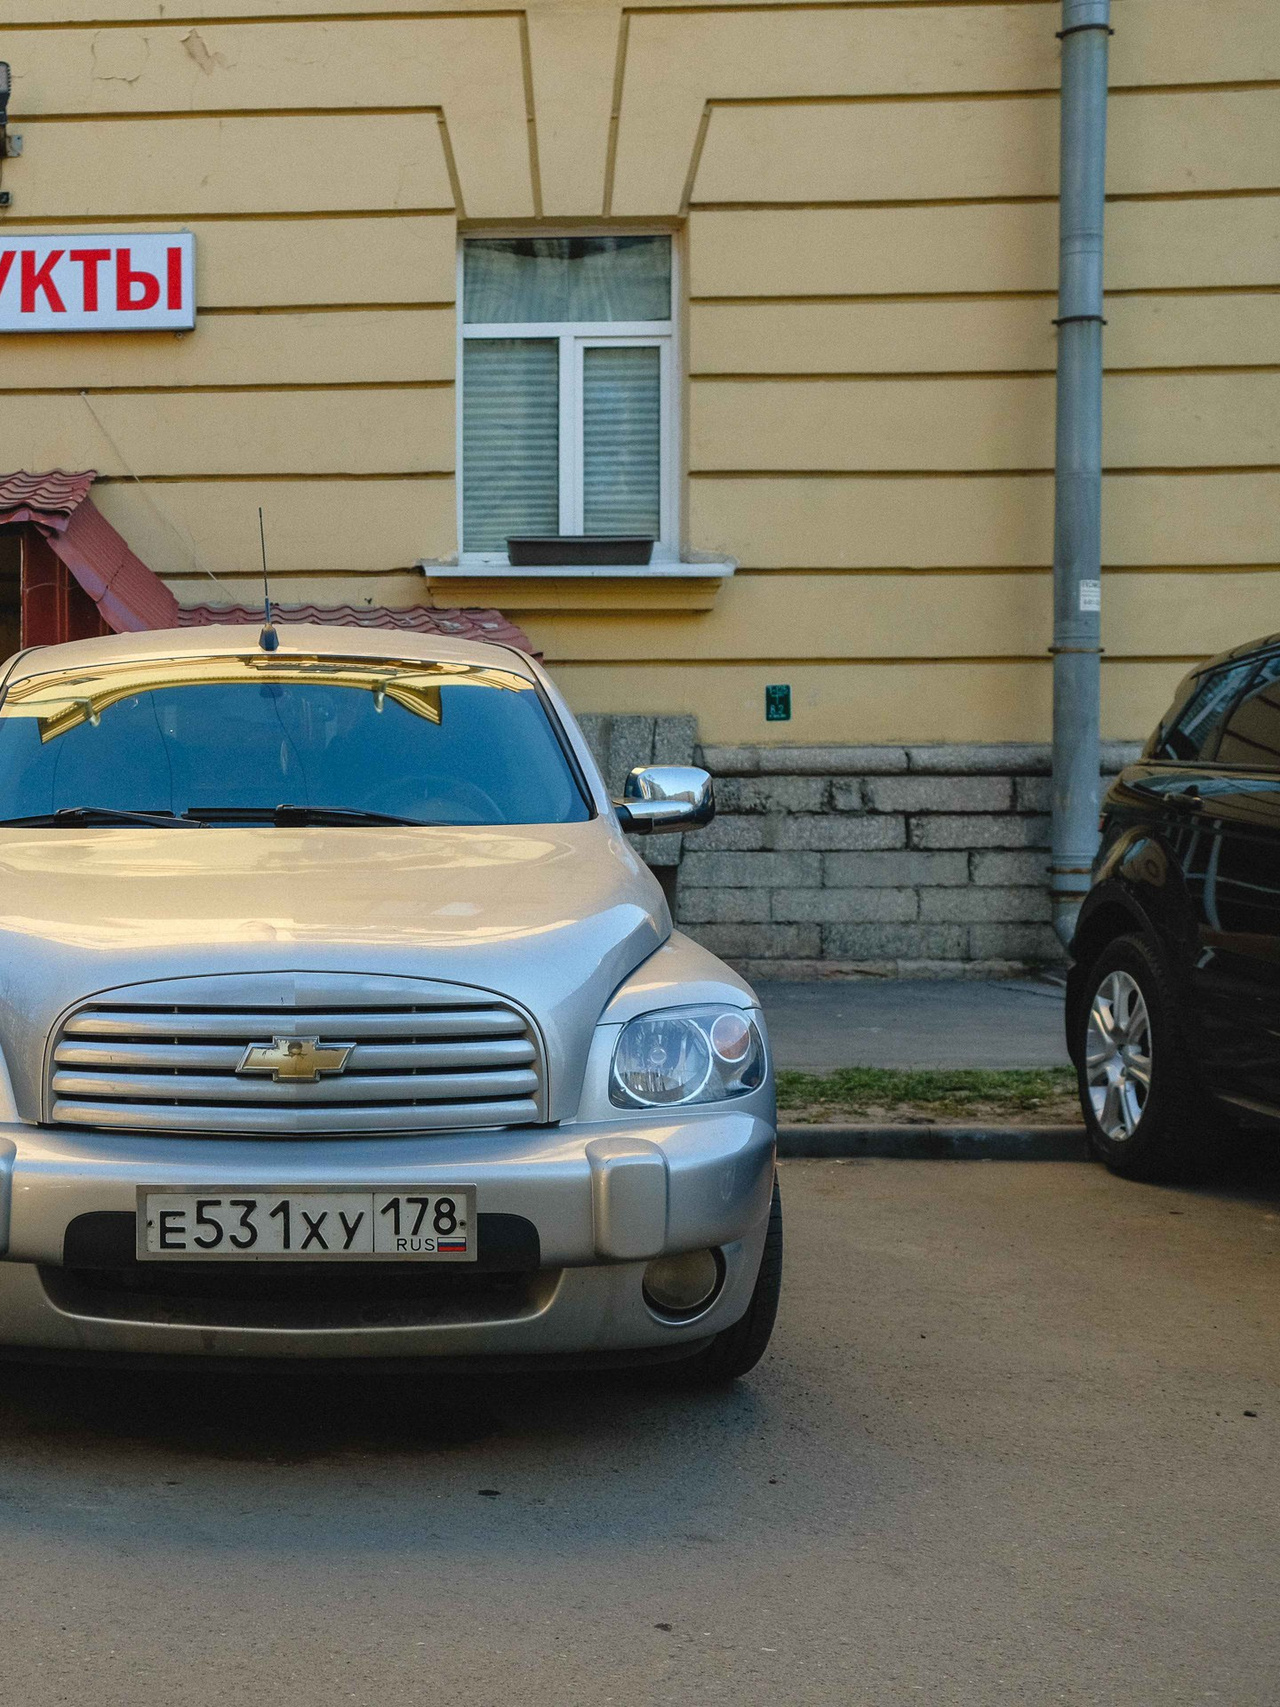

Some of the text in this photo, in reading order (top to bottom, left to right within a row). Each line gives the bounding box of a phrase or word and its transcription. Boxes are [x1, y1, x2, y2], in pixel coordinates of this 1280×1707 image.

[159, 1197, 458, 1250] Е531ХУ 178
[396, 1237, 436, 1252] RUS
